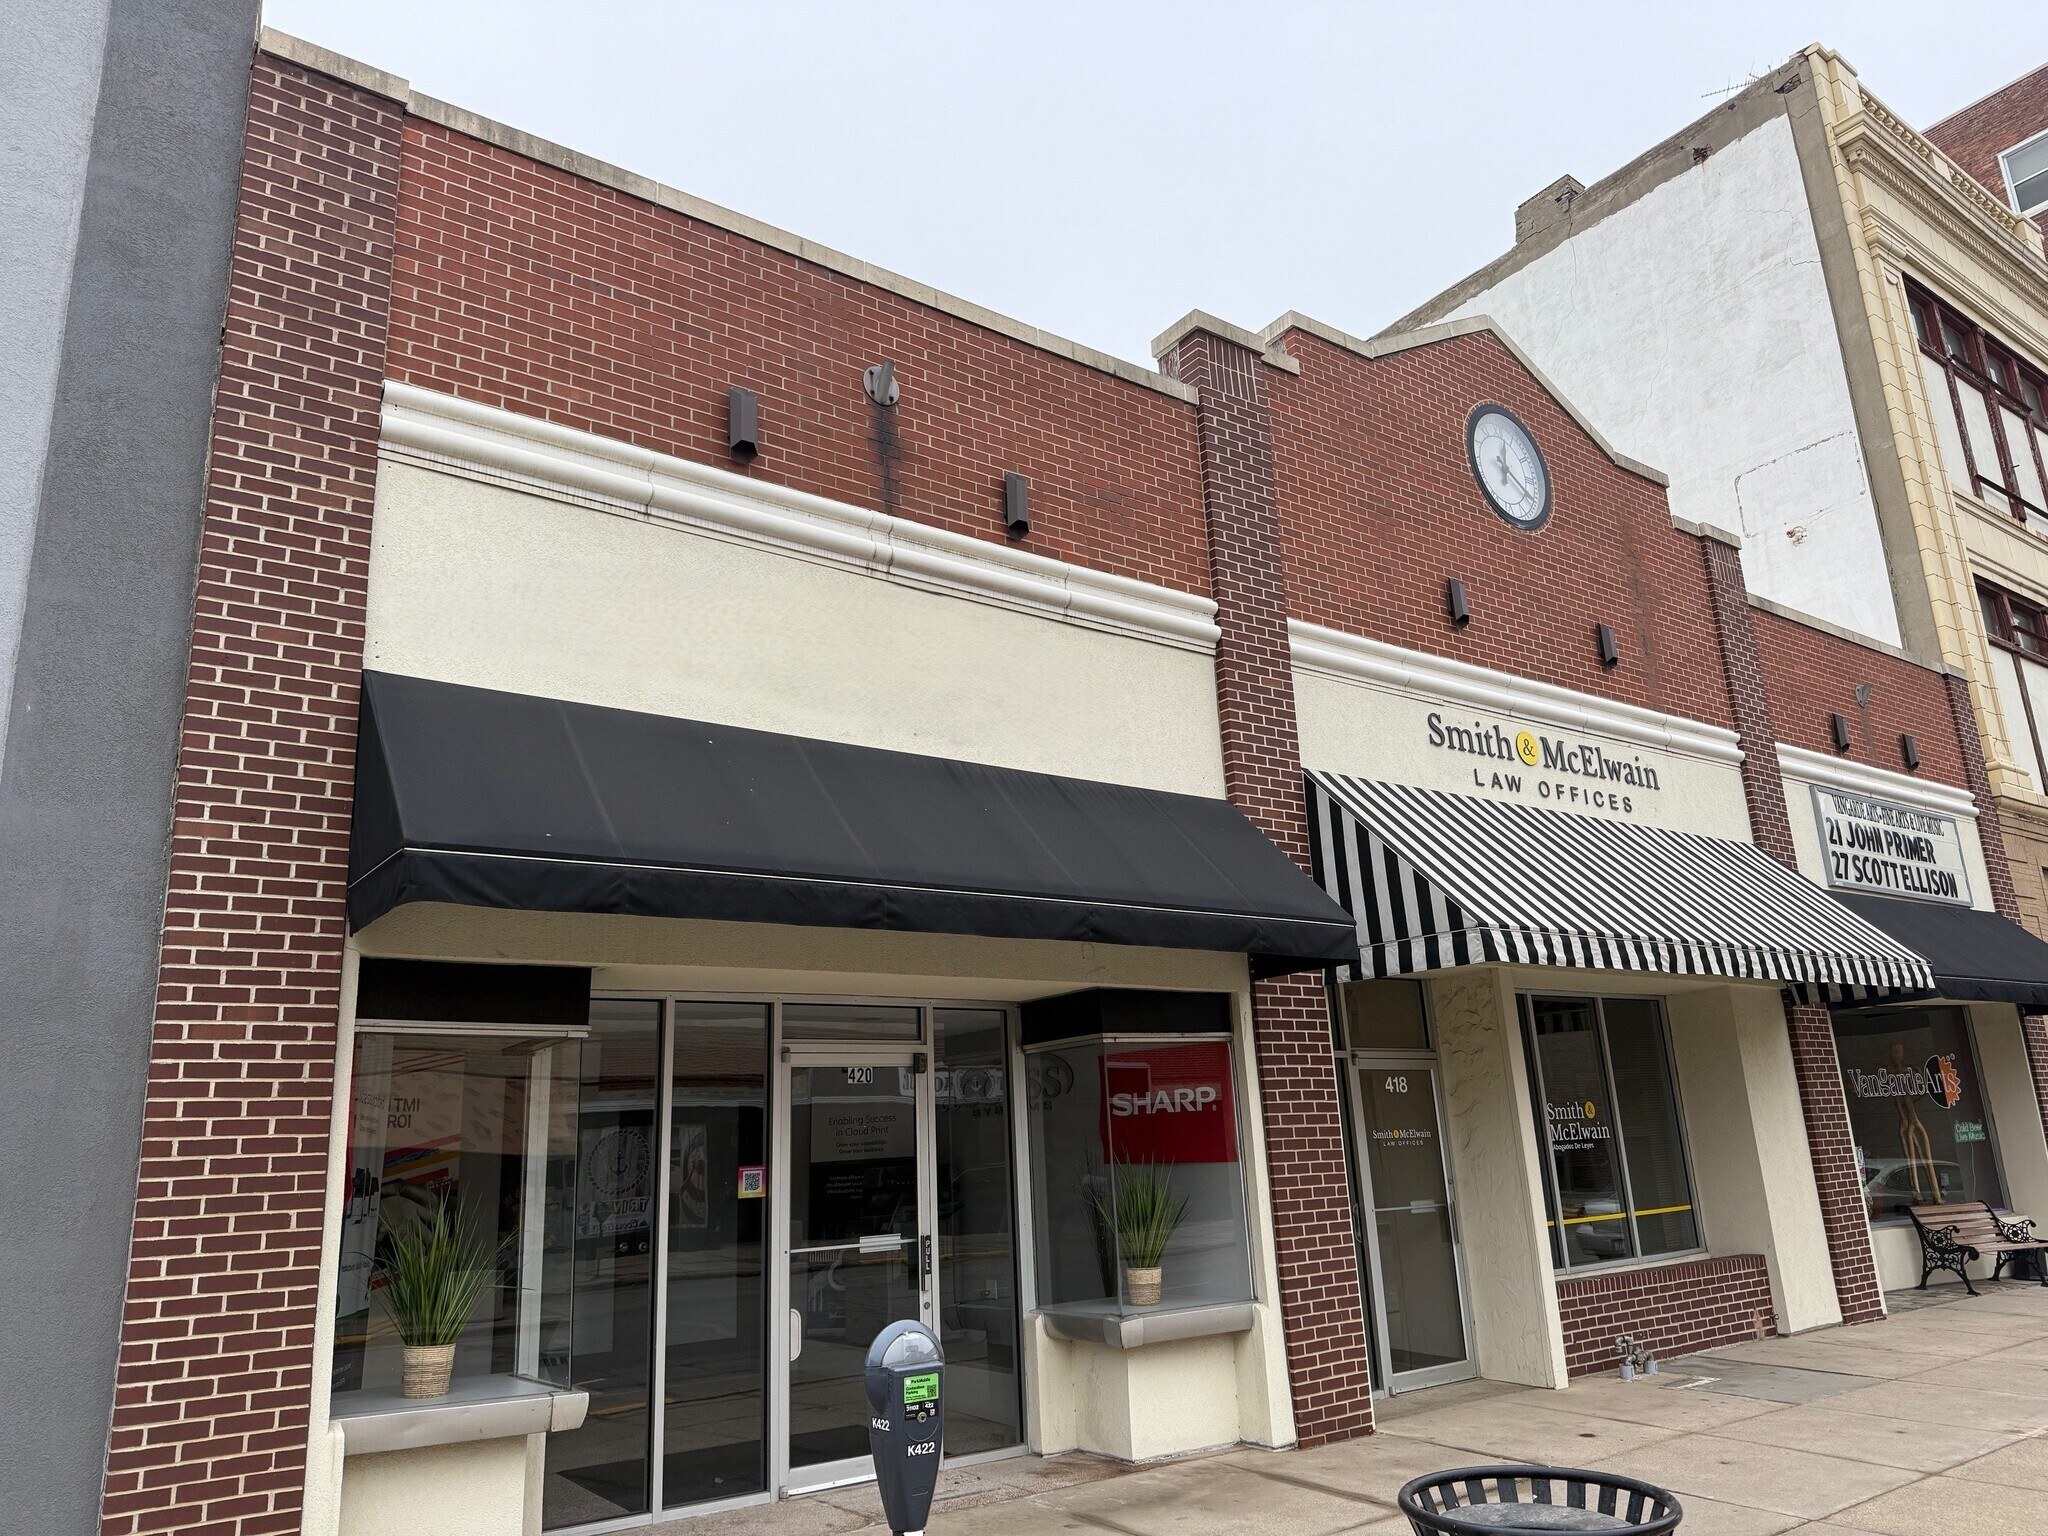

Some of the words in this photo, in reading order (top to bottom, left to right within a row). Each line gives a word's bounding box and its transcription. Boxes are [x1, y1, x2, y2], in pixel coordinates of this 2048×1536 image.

[1428, 712, 1514, 761] Smith
[1540, 736, 1660, 790] McElwain
[1474, 768, 1522, 793] LAW
[1538, 780, 1633, 813] OFFICES
[1826, 816, 1844, 846] 21
[1846, 821, 1884, 854] JOHN
[1884, 830, 1937, 864] PRIMER
[1832, 850, 1849, 880] 27
[1852, 854, 1900, 889] SCOTT
[1900, 865, 1959, 898] ELLISON
[848, 1067, 872, 1083] 420
[1385, 1076, 1408, 1093] 418
[1112, 1086, 1216, 1117] SHARP
[1546, 1101, 1586, 1120] Smith
[828, 1115, 864, 1126] Enabling
[865, 1114, 896, 1124] Success
[1956, 1122, 1969, 1132] Cold
[836, 1129, 842, 1137] in
[845, 1126, 868, 1136] Cloud
[870, 1126, 889, 1135] Print
[1372, 1129, 1394, 1139] Smith
[1399, 1128, 1432, 1139] McElwain
[1550, 1122, 1611, 1142] McElwain
[1582, 1142, 1594, 1150] Leyes
[872, 1418, 890, 1432] K422
[907, 1442, 935, 1456] K422
